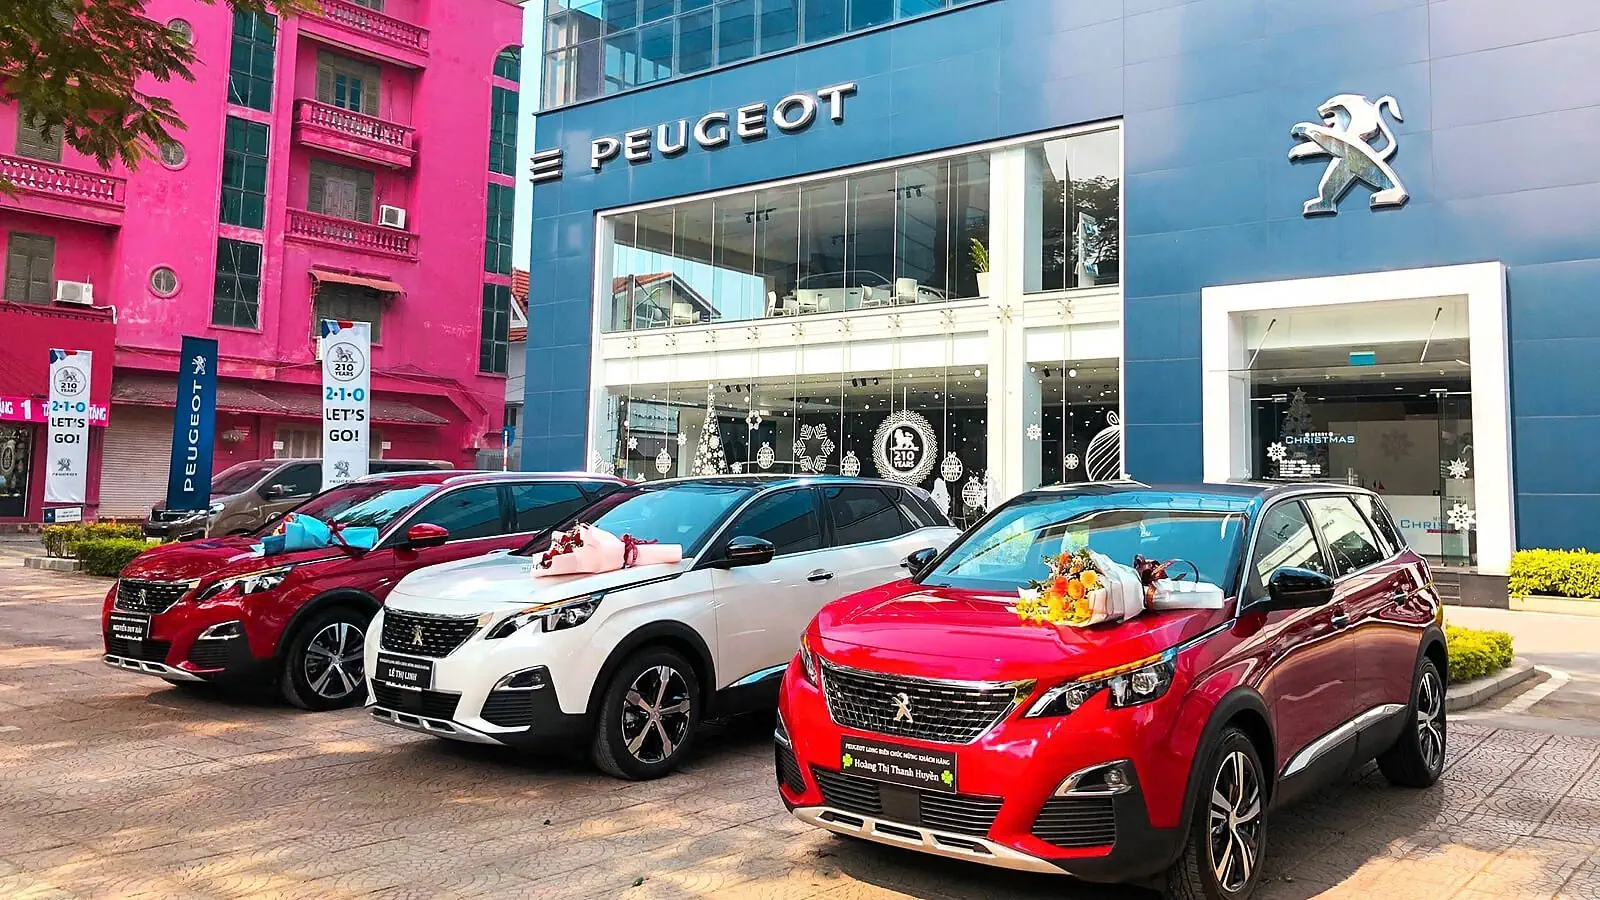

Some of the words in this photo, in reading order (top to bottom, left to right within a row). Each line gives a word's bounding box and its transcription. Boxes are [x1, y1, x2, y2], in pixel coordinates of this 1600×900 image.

[590, 82, 858, 171] PEUGEOT
[334, 363, 354, 371] 210
[21, 399, 32, 420] 1
[326, 408, 365, 421] LET'S
[51, 417, 86, 429] LET'S
[54, 434, 81, 444] GO!
[183, 380, 202, 492] PEUGEOT
[329, 429, 359, 442] GO!
[1285, 435, 1356, 444] CHRISTMAS
[893, 450, 915, 461] 210
[845, 743, 865, 751] PEUGEOT
[854, 758, 877, 773] Hoàng
[877, 762, 890, 775] Thị
[890, 765, 914, 777] Thanh
[915, 769, 939, 782] Huyền
